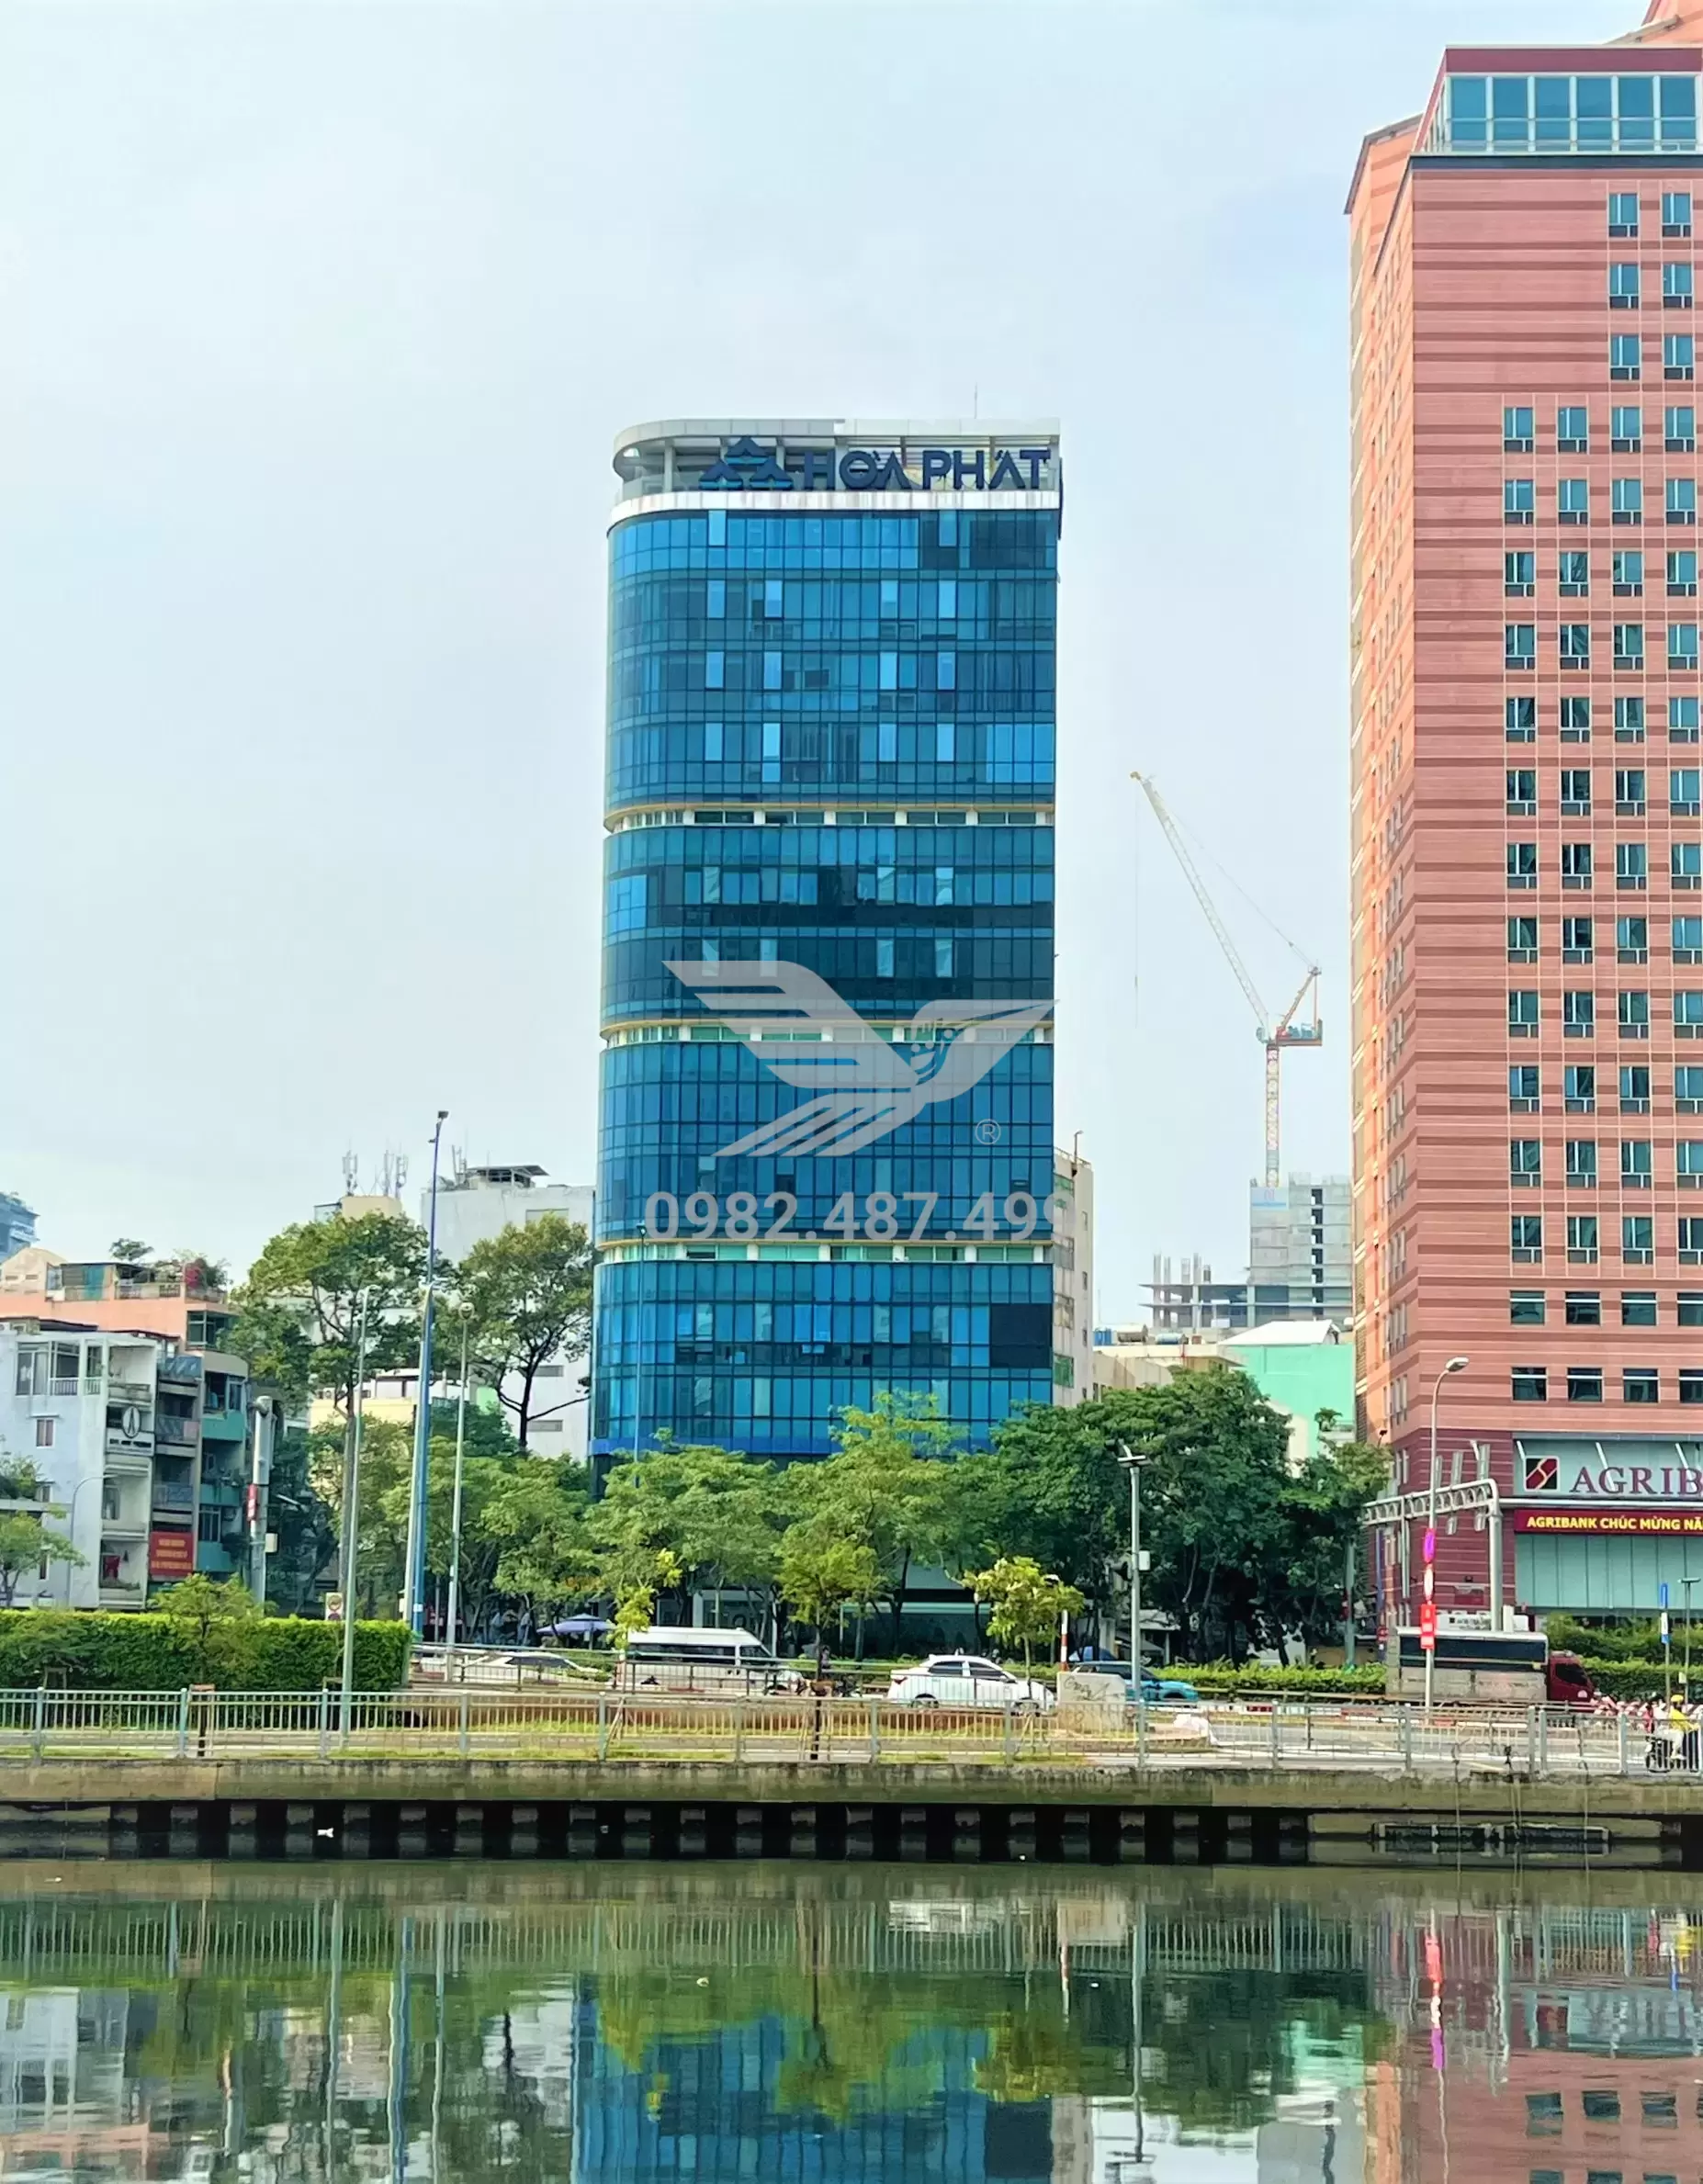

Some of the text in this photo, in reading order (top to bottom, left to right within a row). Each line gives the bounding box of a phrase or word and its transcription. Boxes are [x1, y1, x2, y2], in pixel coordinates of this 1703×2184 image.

[921, 449, 1051, 490] PHÁT
[1569, 1466, 1703, 1495] AGRIB
[1527, 1515, 1597, 1529] AGRIBANK
[1600, 1514, 1637, 1530] CHÚC
[1640, 1515, 1681, 1531] MỪNG
